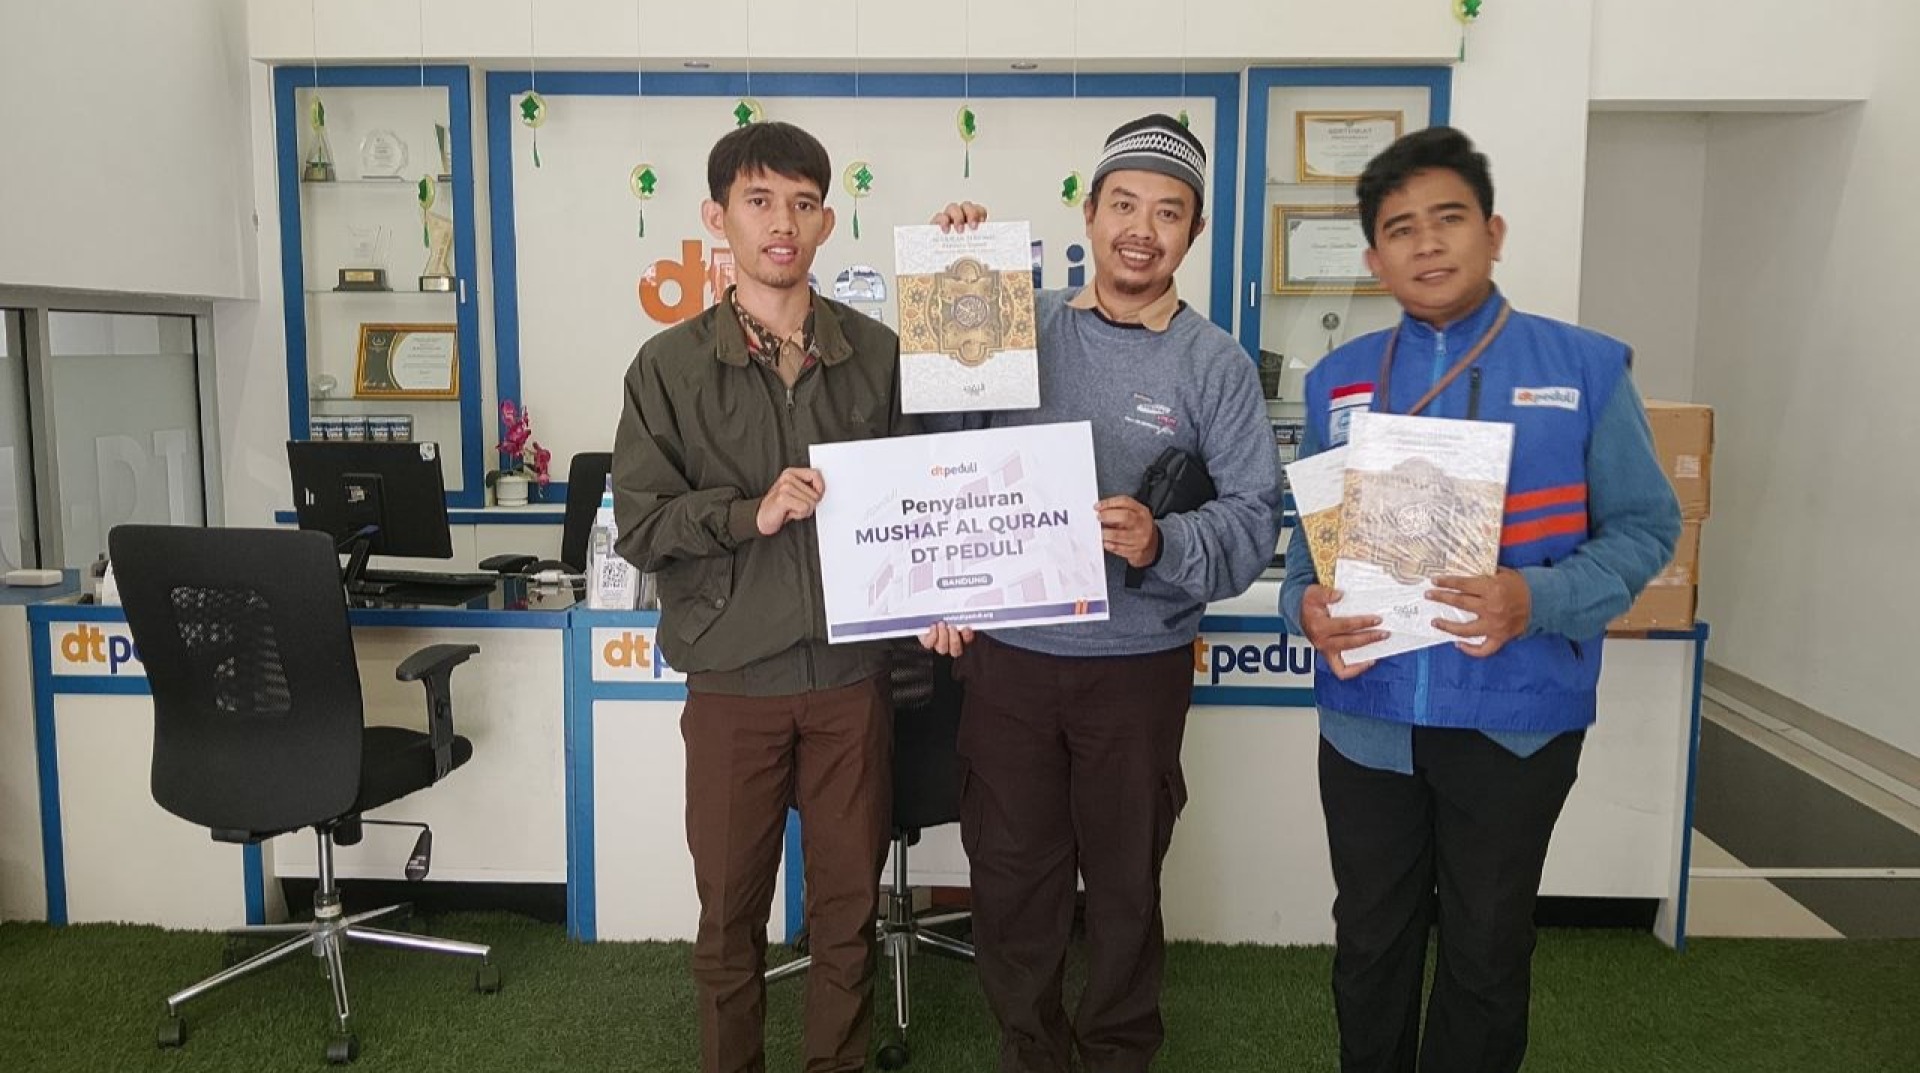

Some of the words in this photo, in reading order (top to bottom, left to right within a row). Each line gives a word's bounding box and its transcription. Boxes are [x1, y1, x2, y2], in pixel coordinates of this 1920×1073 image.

[931, 462, 978, 479] dtpeduli
[901, 491, 1024, 516] Penyaluran
[855, 520, 949, 545] MUSHAF
[955, 517, 983, 535] AL
[988, 509, 1069, 534] QURAN
[911, 546, 940, 564] DT
[946, 539, 1024, 561] PEDULI
[941, 575, 988, 587] BANDUNG
